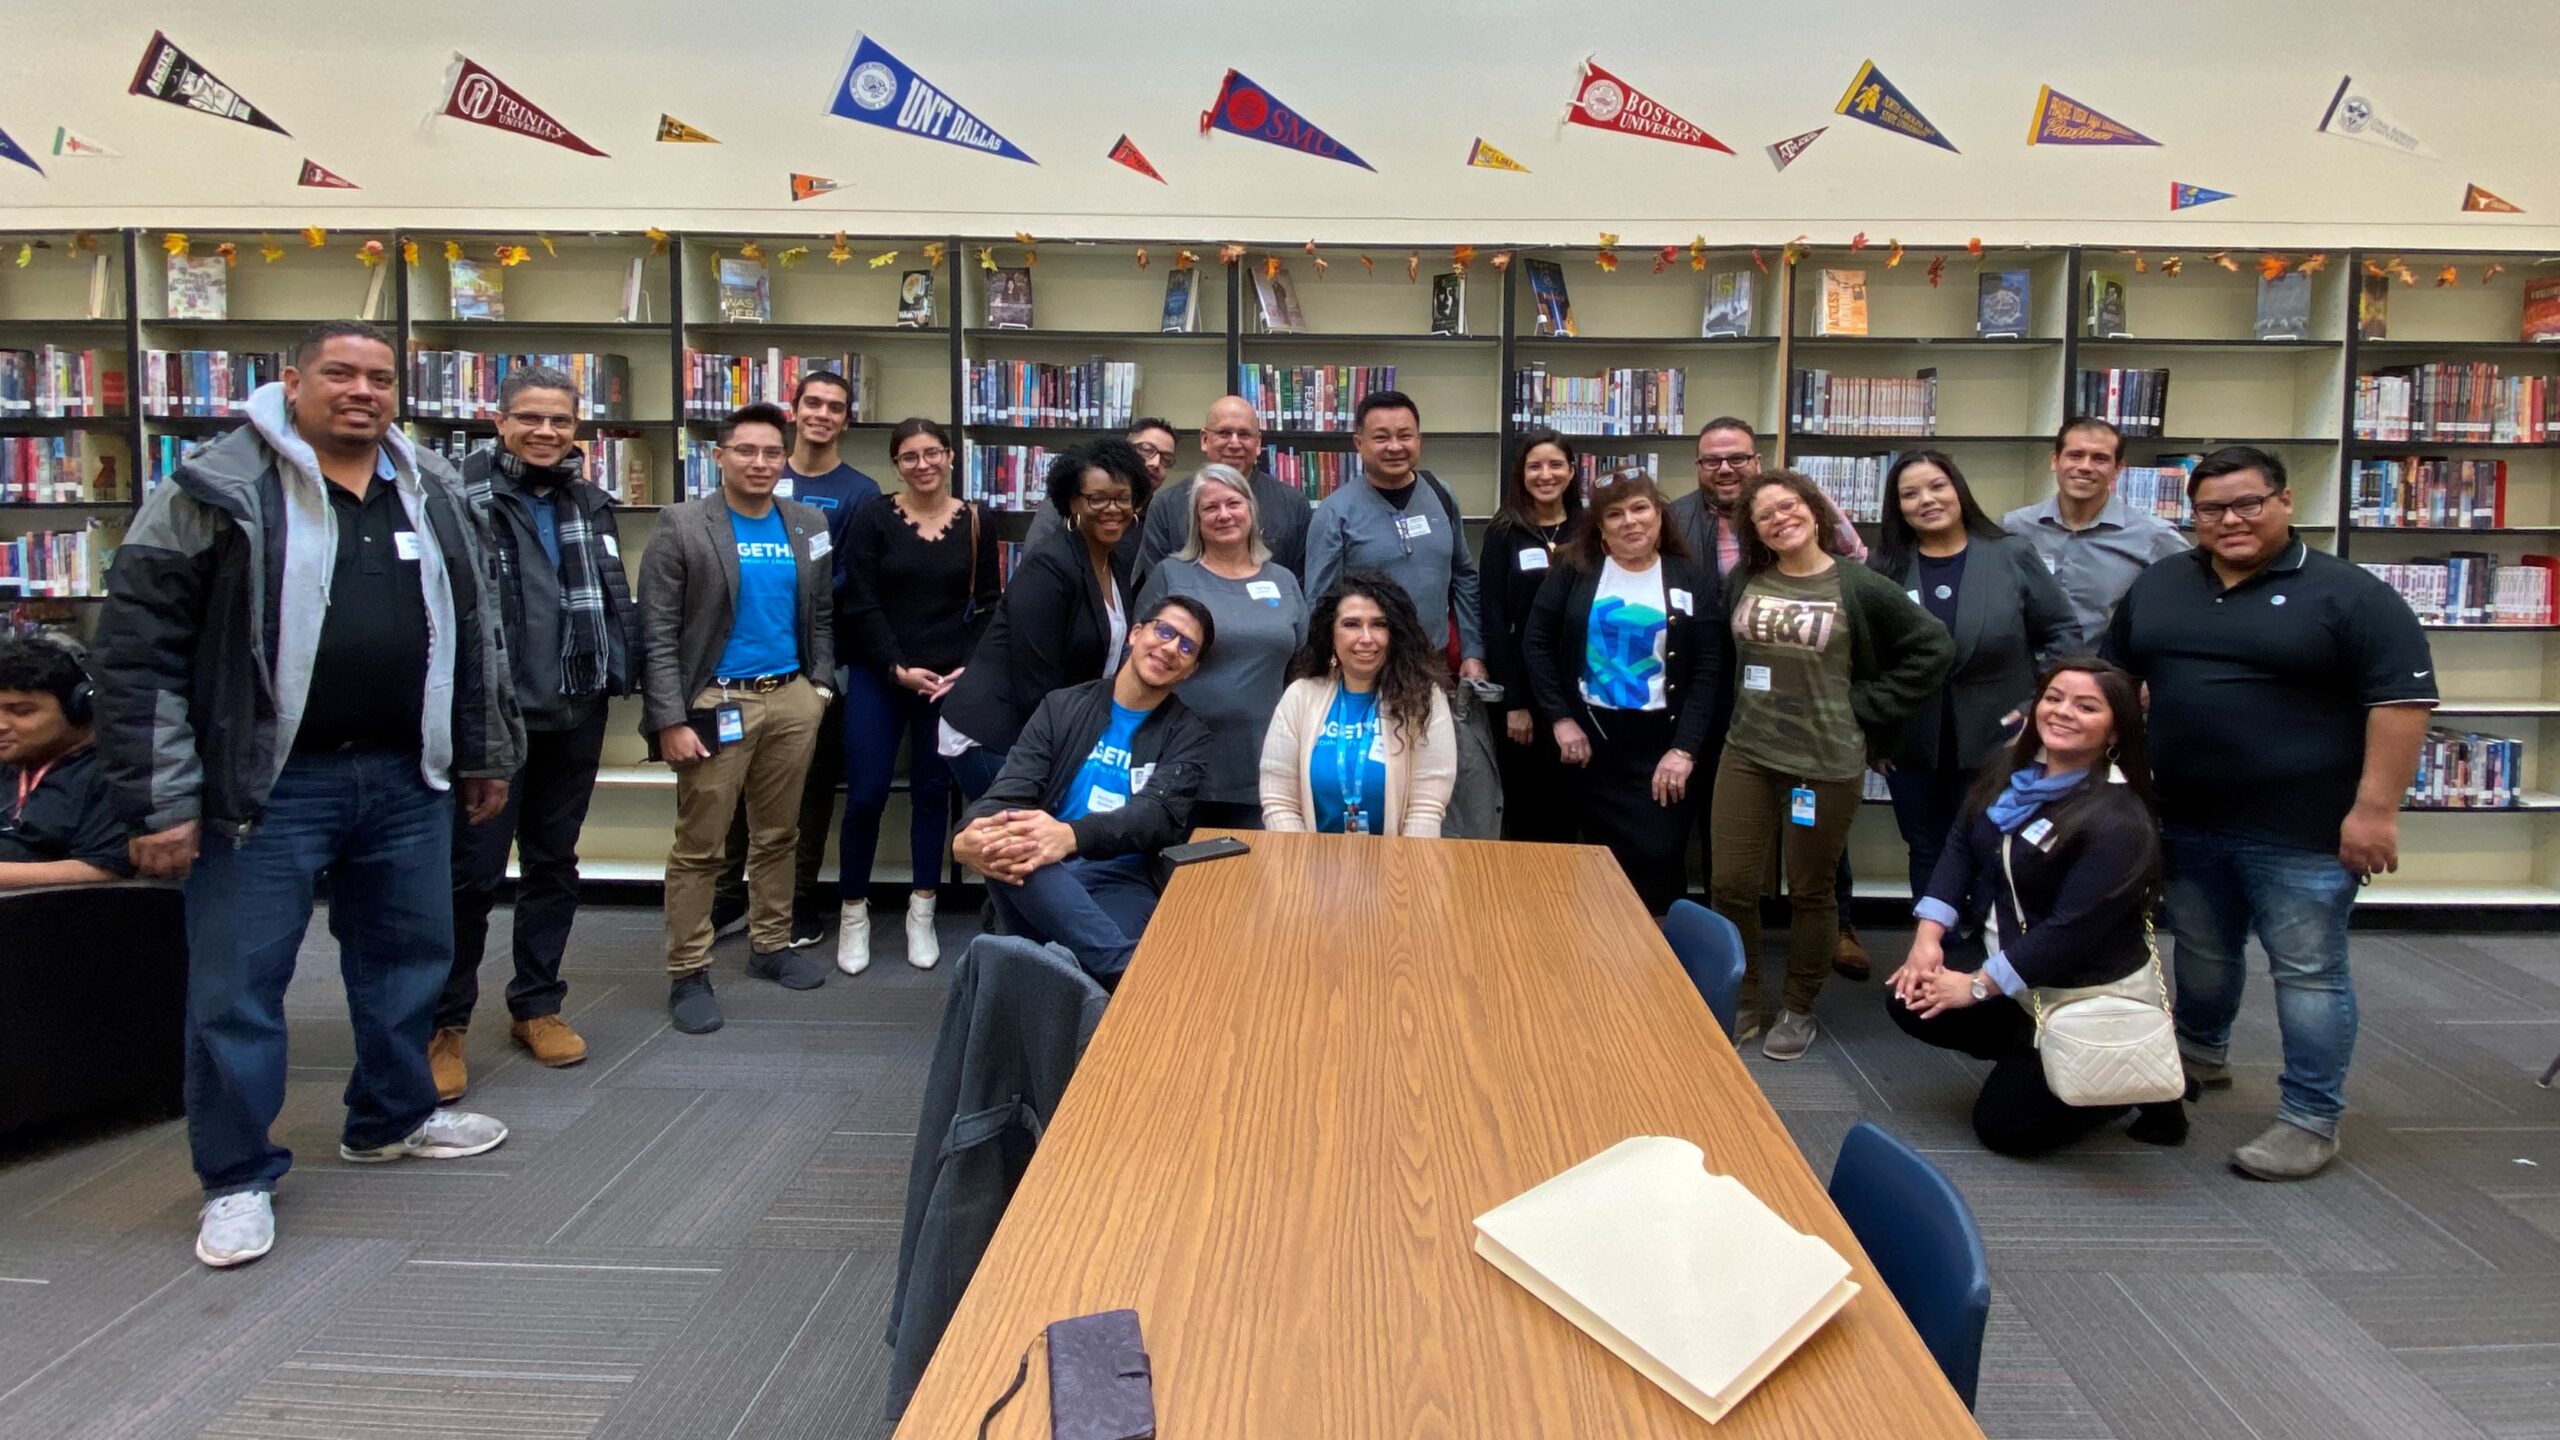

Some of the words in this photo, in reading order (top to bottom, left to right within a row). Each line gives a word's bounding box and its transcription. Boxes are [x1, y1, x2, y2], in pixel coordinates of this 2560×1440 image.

[496, 94, 566, 138] TRINITY
[896, 77, 953, 136] UNT
[946, 109, 1002, 151] DALLAS
[1265, 108, 1339, 157] SMU
[1619, 112, 1700, 142] UNIVERSITY
[1625, 91, 1703, 139] BOSTON
[725, 298, 754, 308] WAS
[737, 543, 794, 558] GETH
